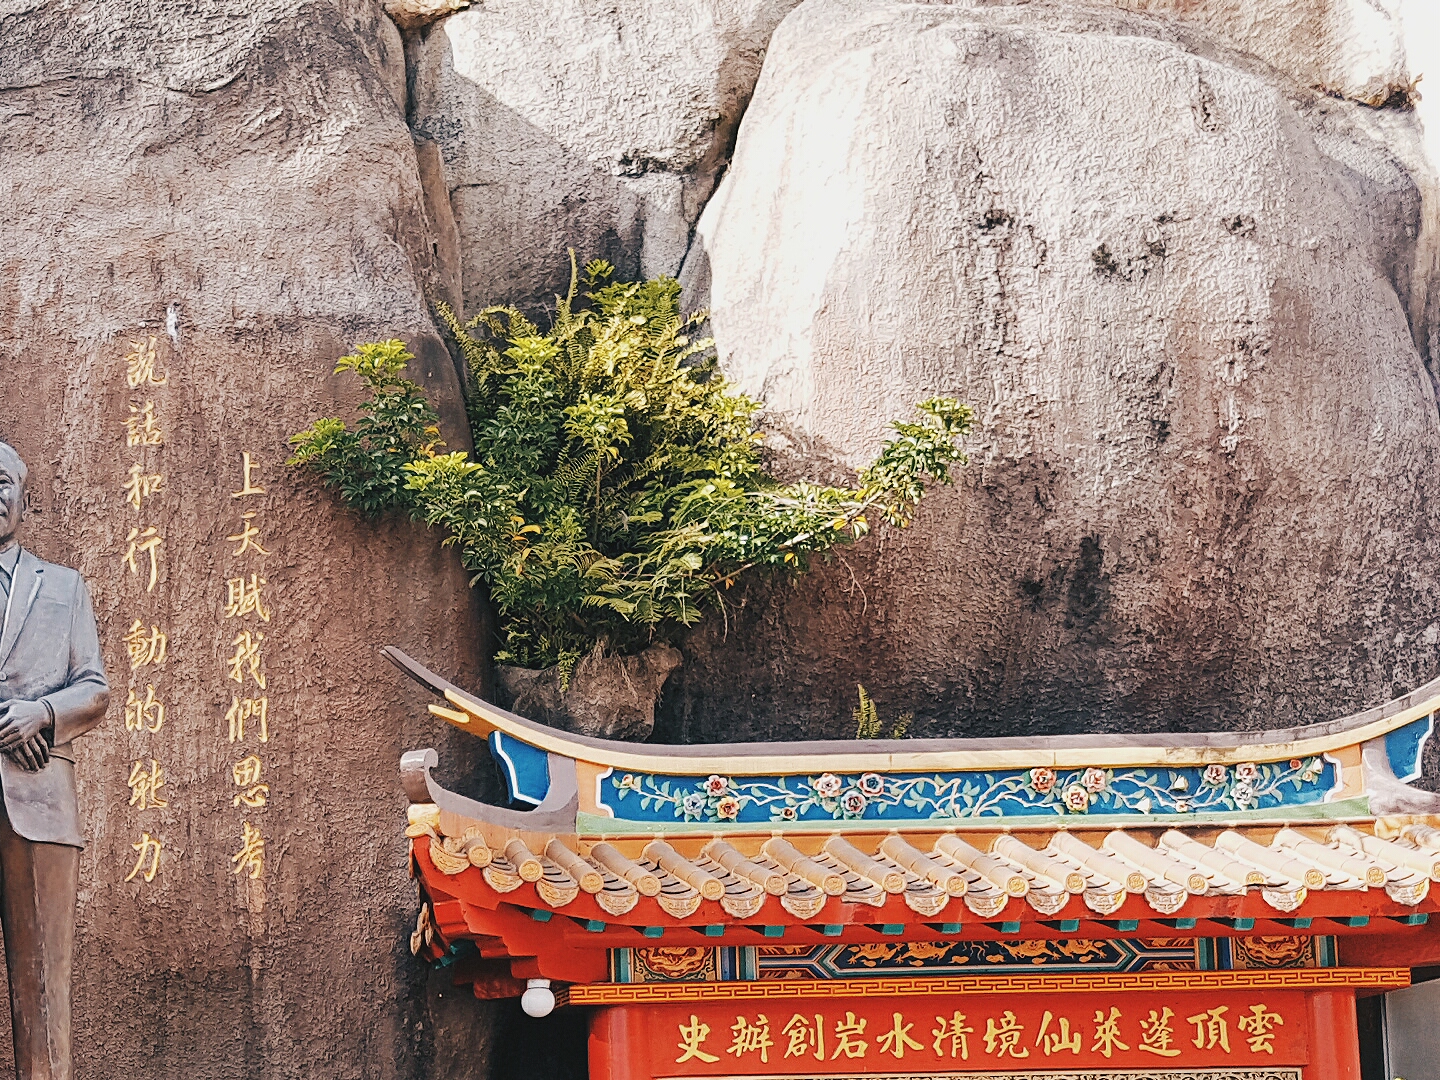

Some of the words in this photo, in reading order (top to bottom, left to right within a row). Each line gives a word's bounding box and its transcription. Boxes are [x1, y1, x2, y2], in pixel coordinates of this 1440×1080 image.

[123, 335, 167, 883] 說話和行動的能力
[225, 451, 270, 880] 上天賦我們思考
